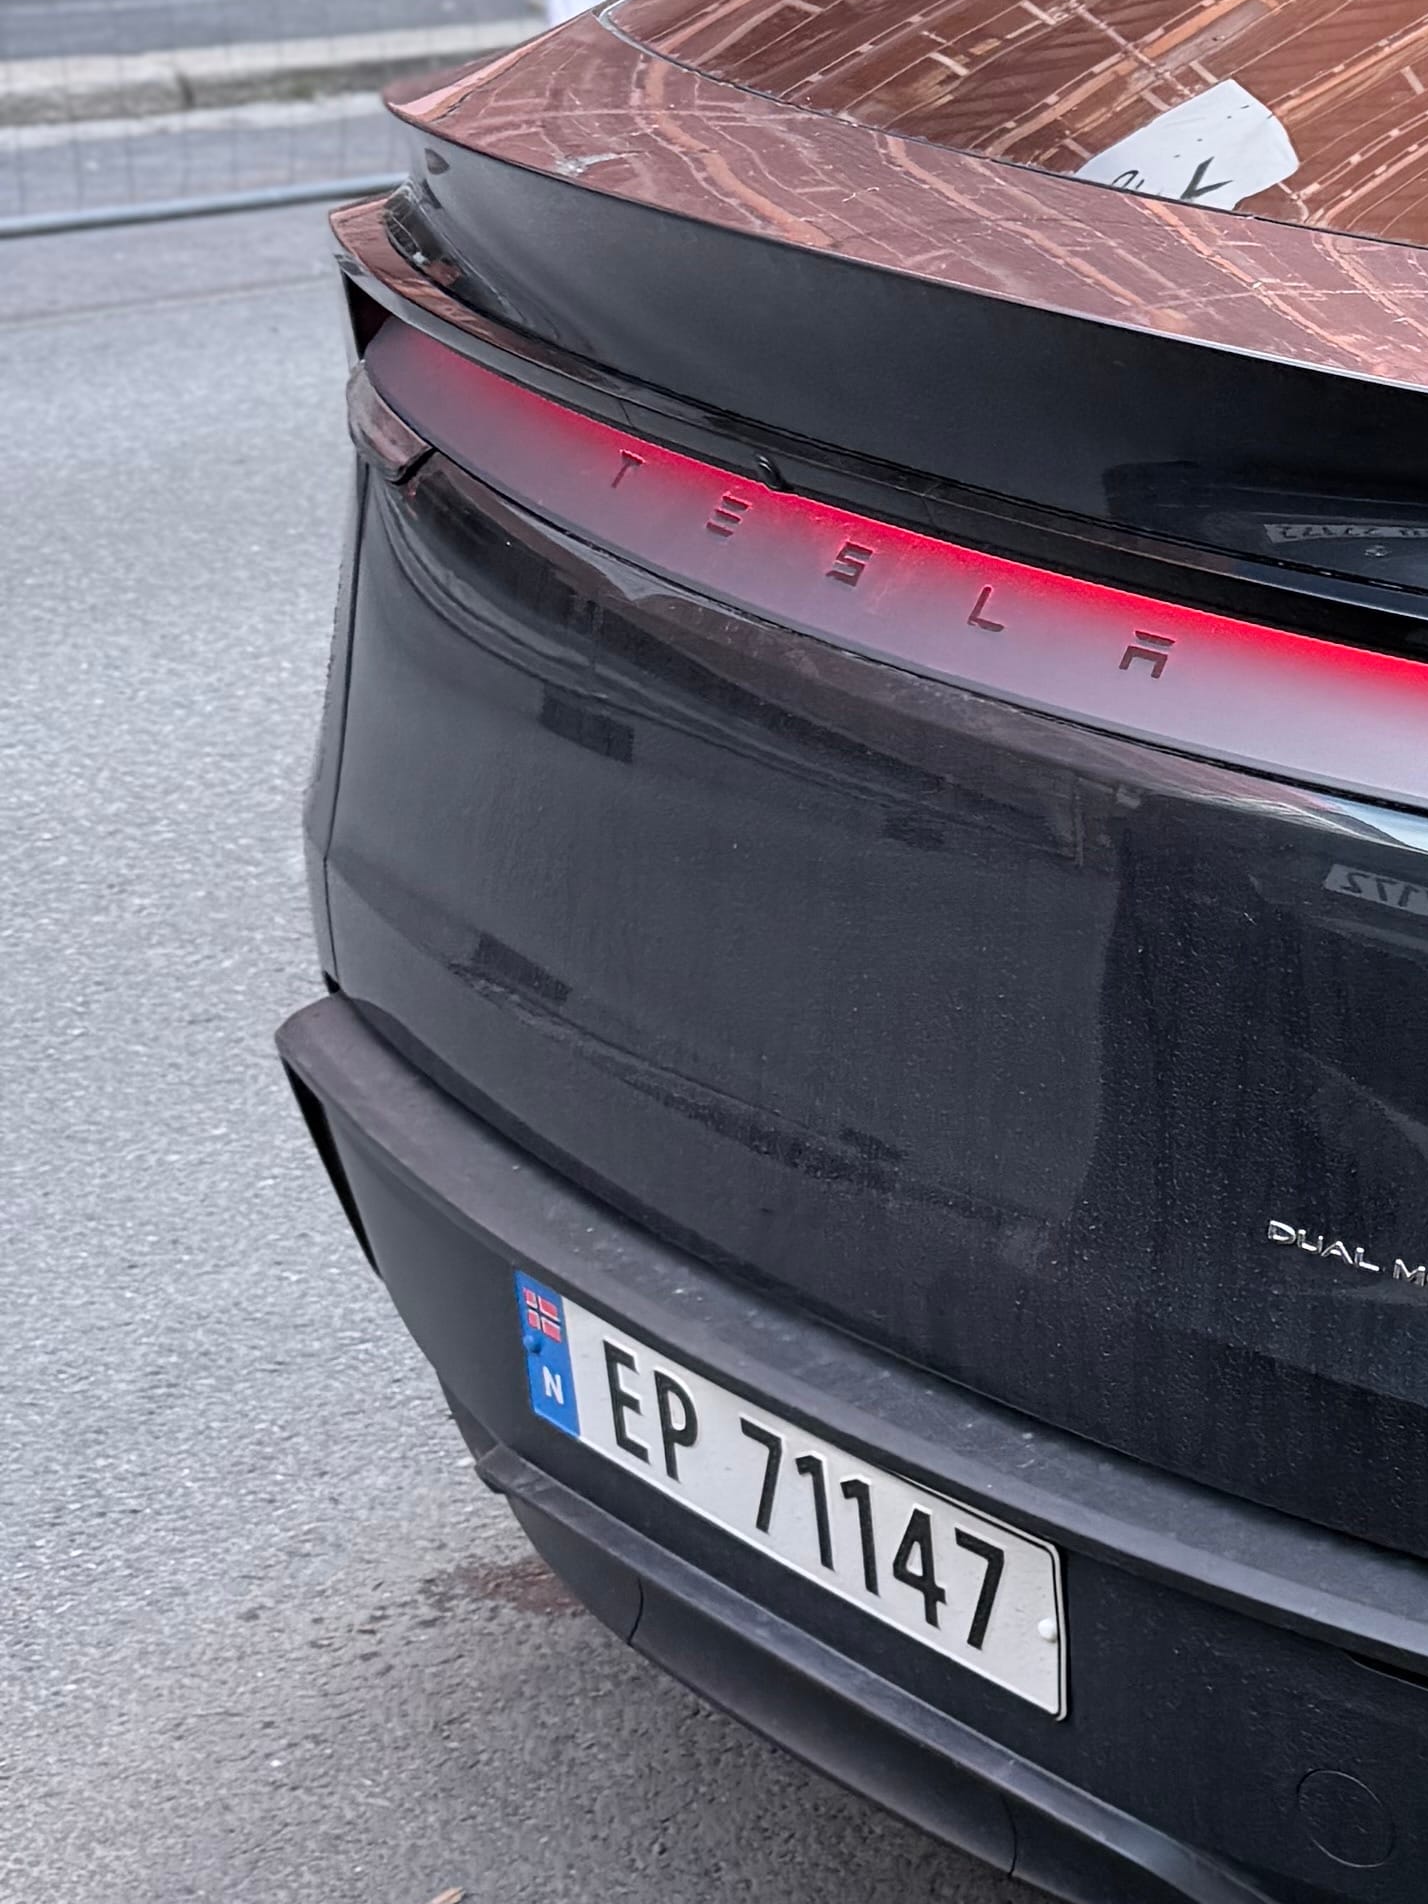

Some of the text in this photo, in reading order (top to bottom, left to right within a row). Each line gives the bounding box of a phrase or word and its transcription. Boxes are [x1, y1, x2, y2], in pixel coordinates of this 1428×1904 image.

[608, 448, 1176, 680] TESLA
[1267, 1219, 1380, 1272] DUAL
[541, 1365, 565, 1406] N
[602, 1336, 1007, 1652] EP 71147
